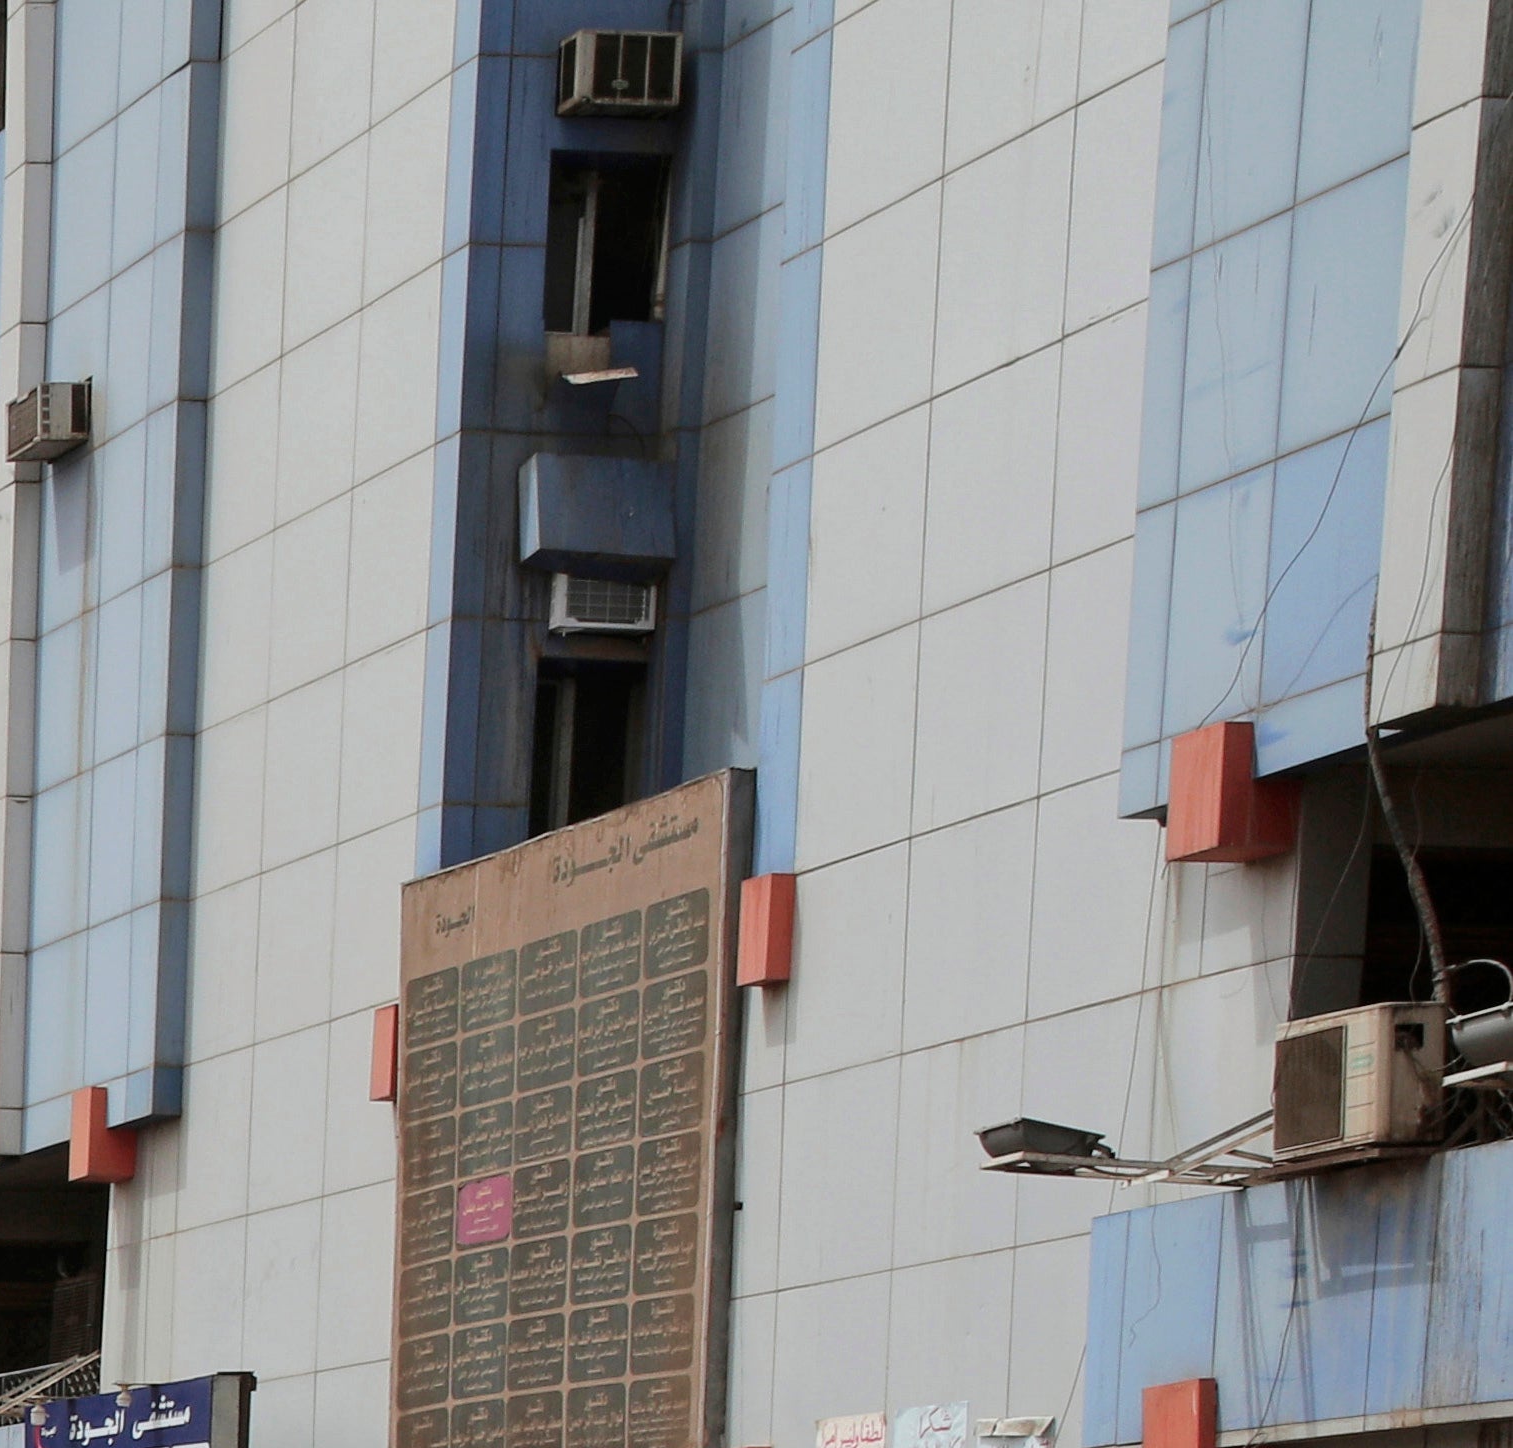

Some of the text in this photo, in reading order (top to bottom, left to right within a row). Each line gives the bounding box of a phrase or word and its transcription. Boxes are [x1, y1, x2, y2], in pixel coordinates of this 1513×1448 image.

[552, 815, 699, 886] مستشفى الجودة
[69, 1395, 191, 1446] مستشفى الجودة
